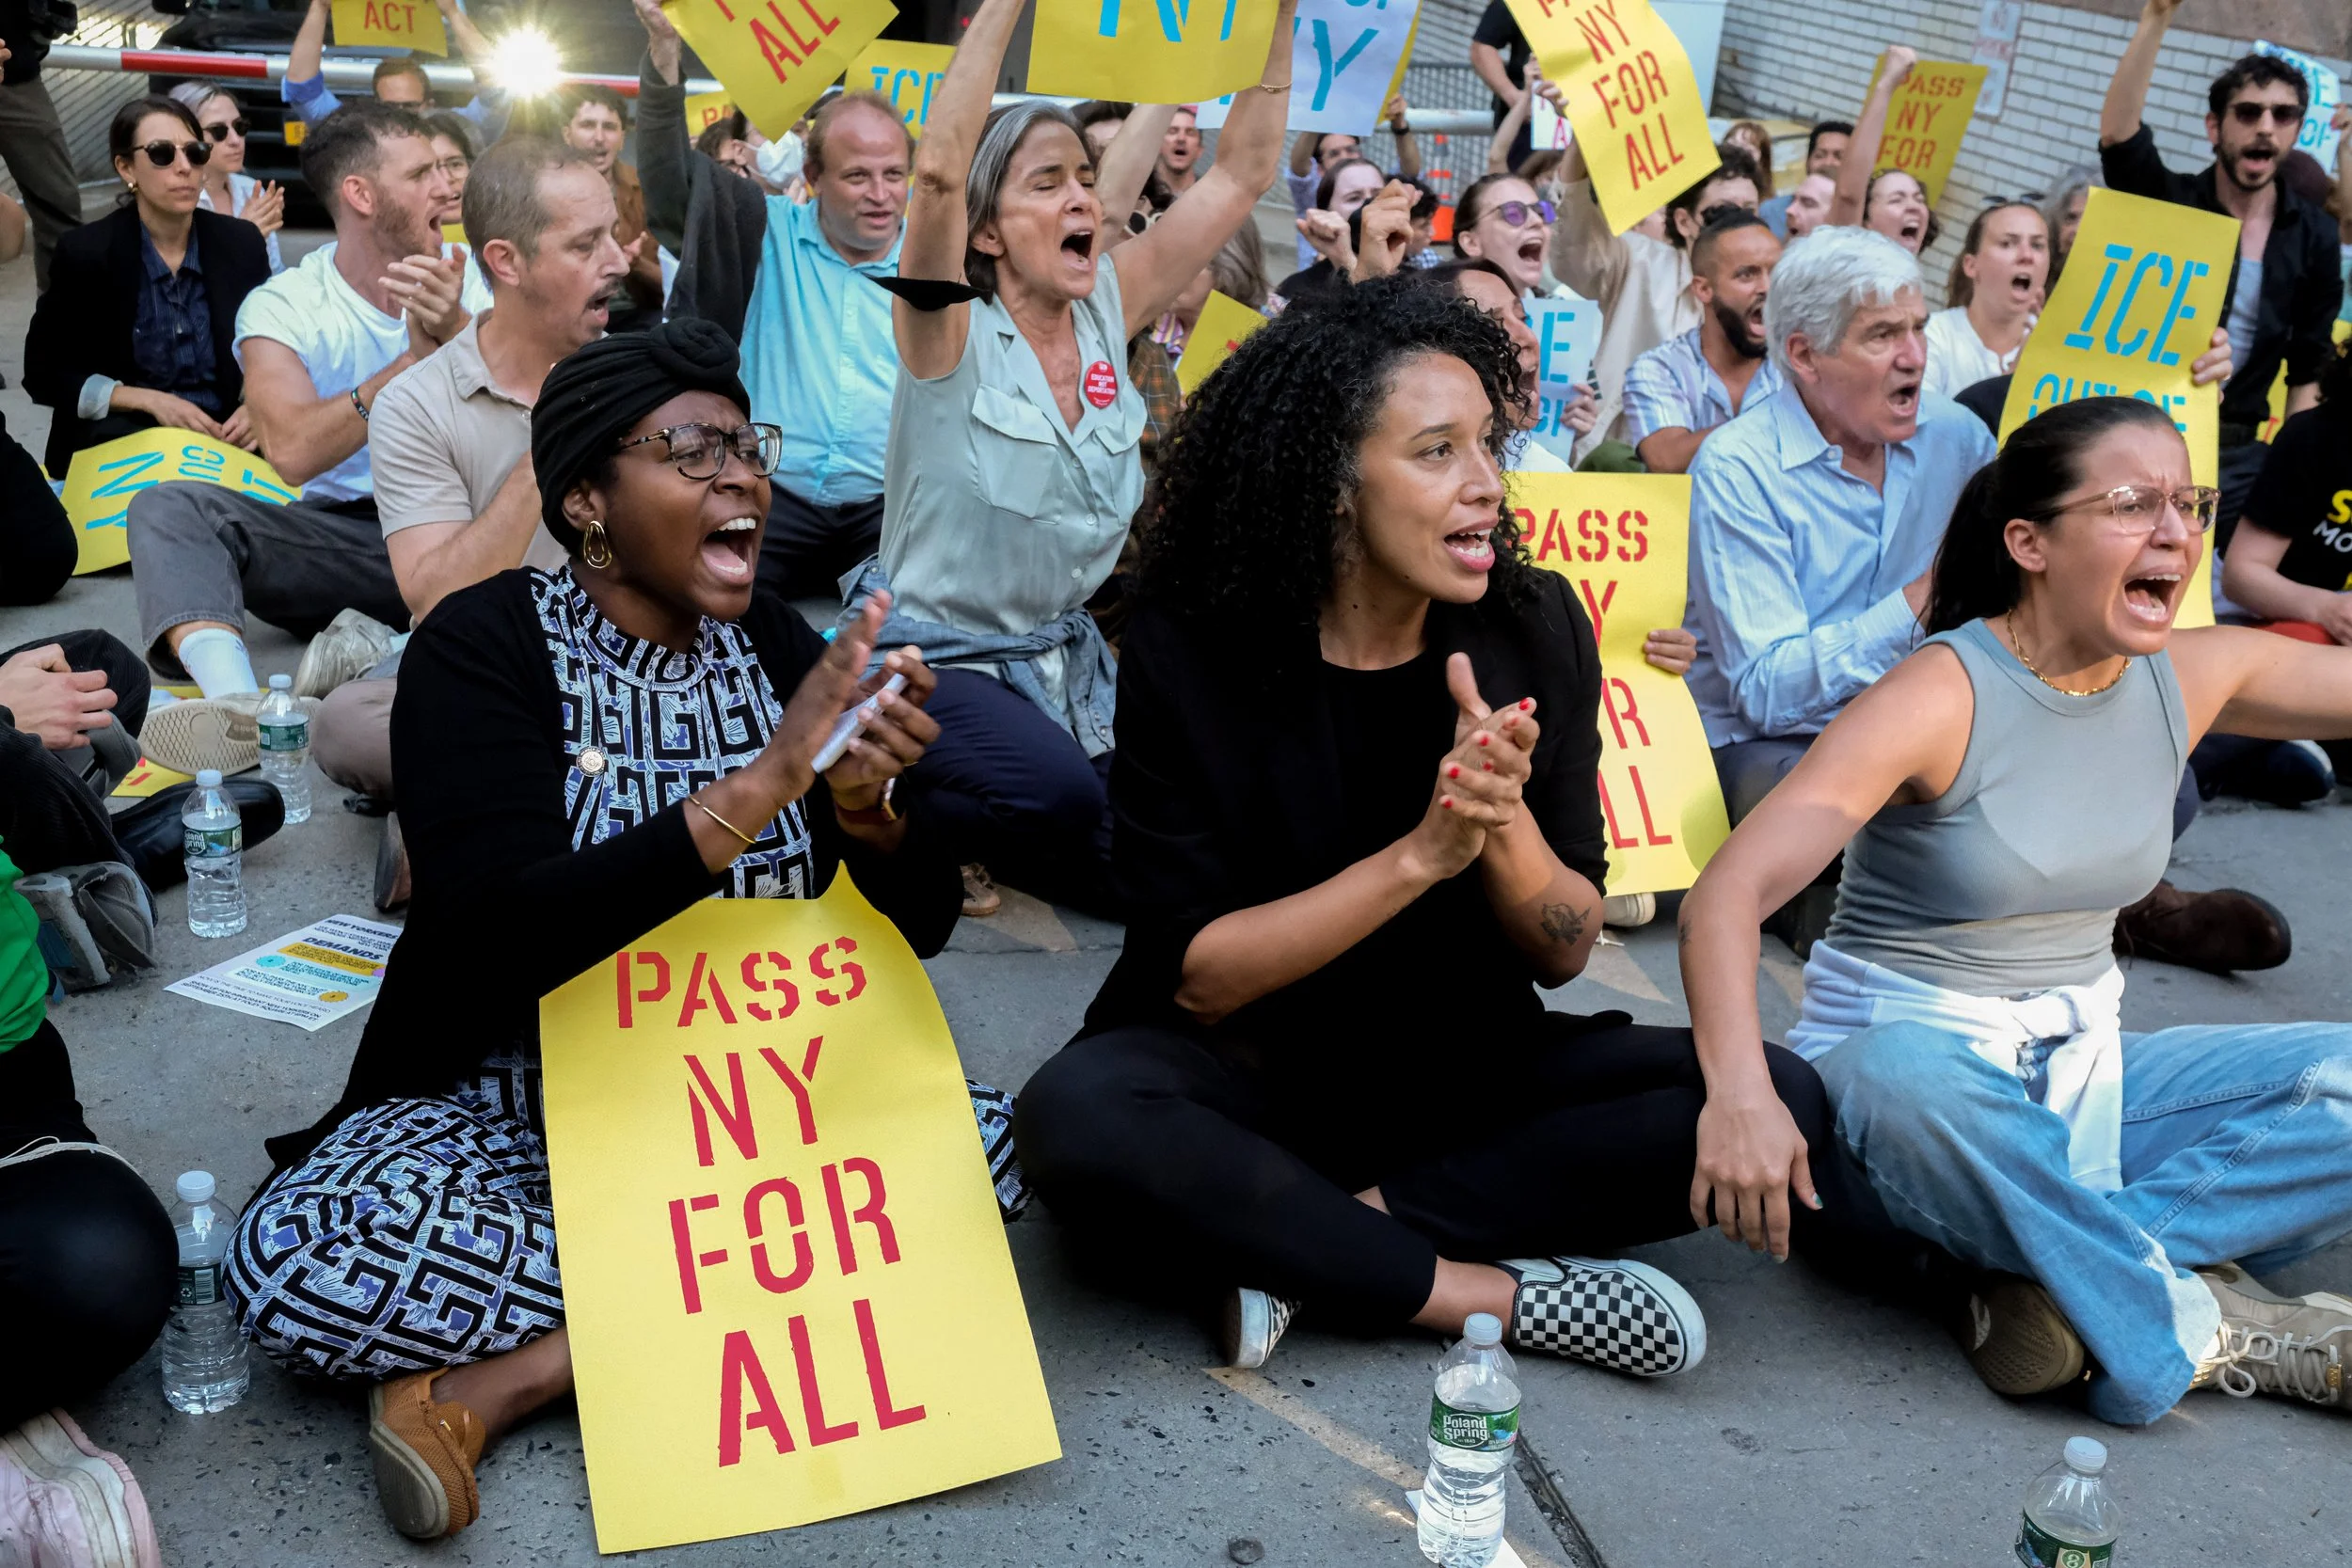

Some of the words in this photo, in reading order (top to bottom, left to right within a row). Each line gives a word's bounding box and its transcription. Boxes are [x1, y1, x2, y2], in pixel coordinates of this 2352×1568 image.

[364, 0, 416, 34] ACT
[749, 0, 840, 84] ALL
[1575, 0, 1630, 64] NY
[1592, 50, 1668, 129] FOR
[1896, 100, 1944, 134] NY
[1626, 112, 1684, 191] ALL
[1877, 135, 1937, 170] FOR
[2063, 243, 2210, 367] ICE
[1597, 765, 1673, 849] LL
[302, 937, 384, 960] DEMANDS
[616, 936, 866, 1028] PASS
[683, 1036, 824, 1166] NY
[668, 1157, 901, 1315] FOR
[718, 1299, 926, 1468] ALL
[1443, 1415, 1487, 1430] Poland
[1443, 1427, 1488, 1441] Spring
